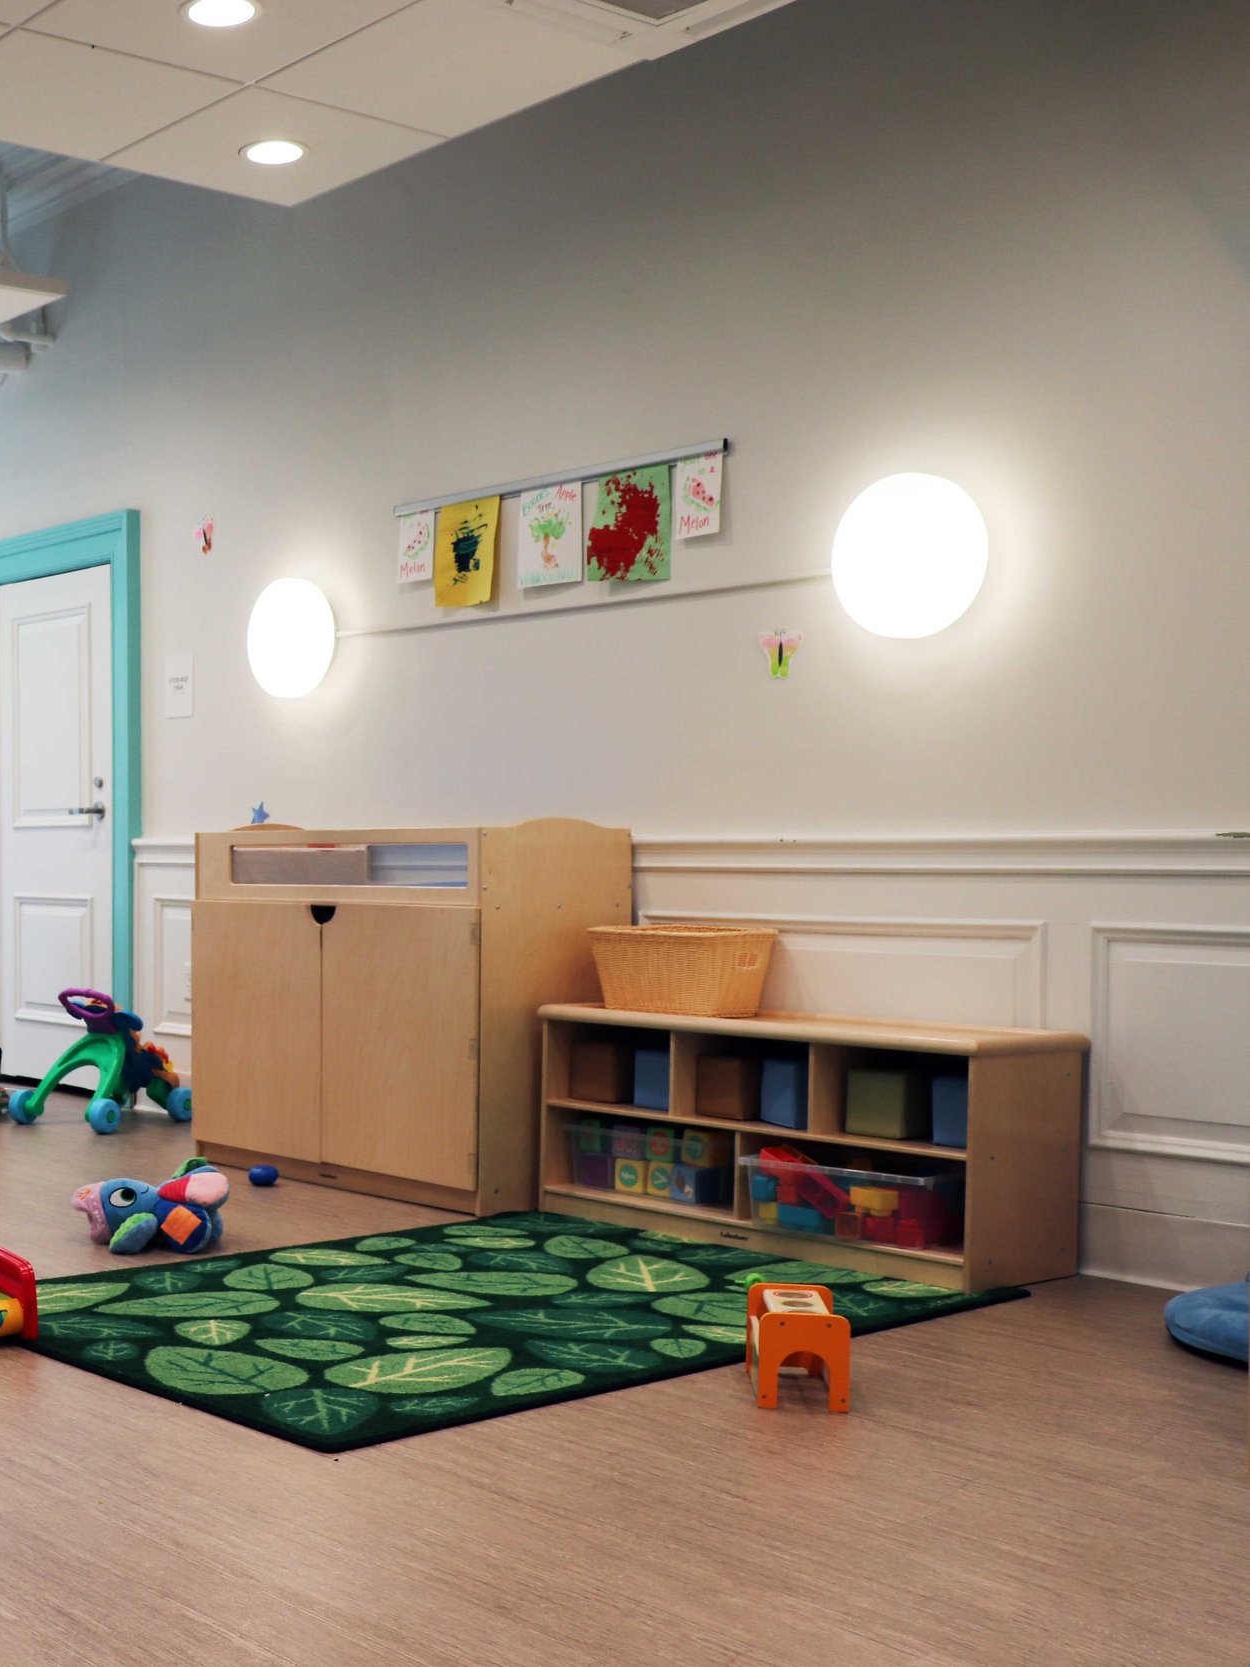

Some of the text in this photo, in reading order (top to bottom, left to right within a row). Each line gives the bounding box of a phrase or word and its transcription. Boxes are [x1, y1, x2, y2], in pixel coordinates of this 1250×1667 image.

[554, 484, 576, 502] Apple
[537, 502, 552, 513] Tree
[679, 514, 710, 535] Melon
[400, 562, 426, 577] Melon
